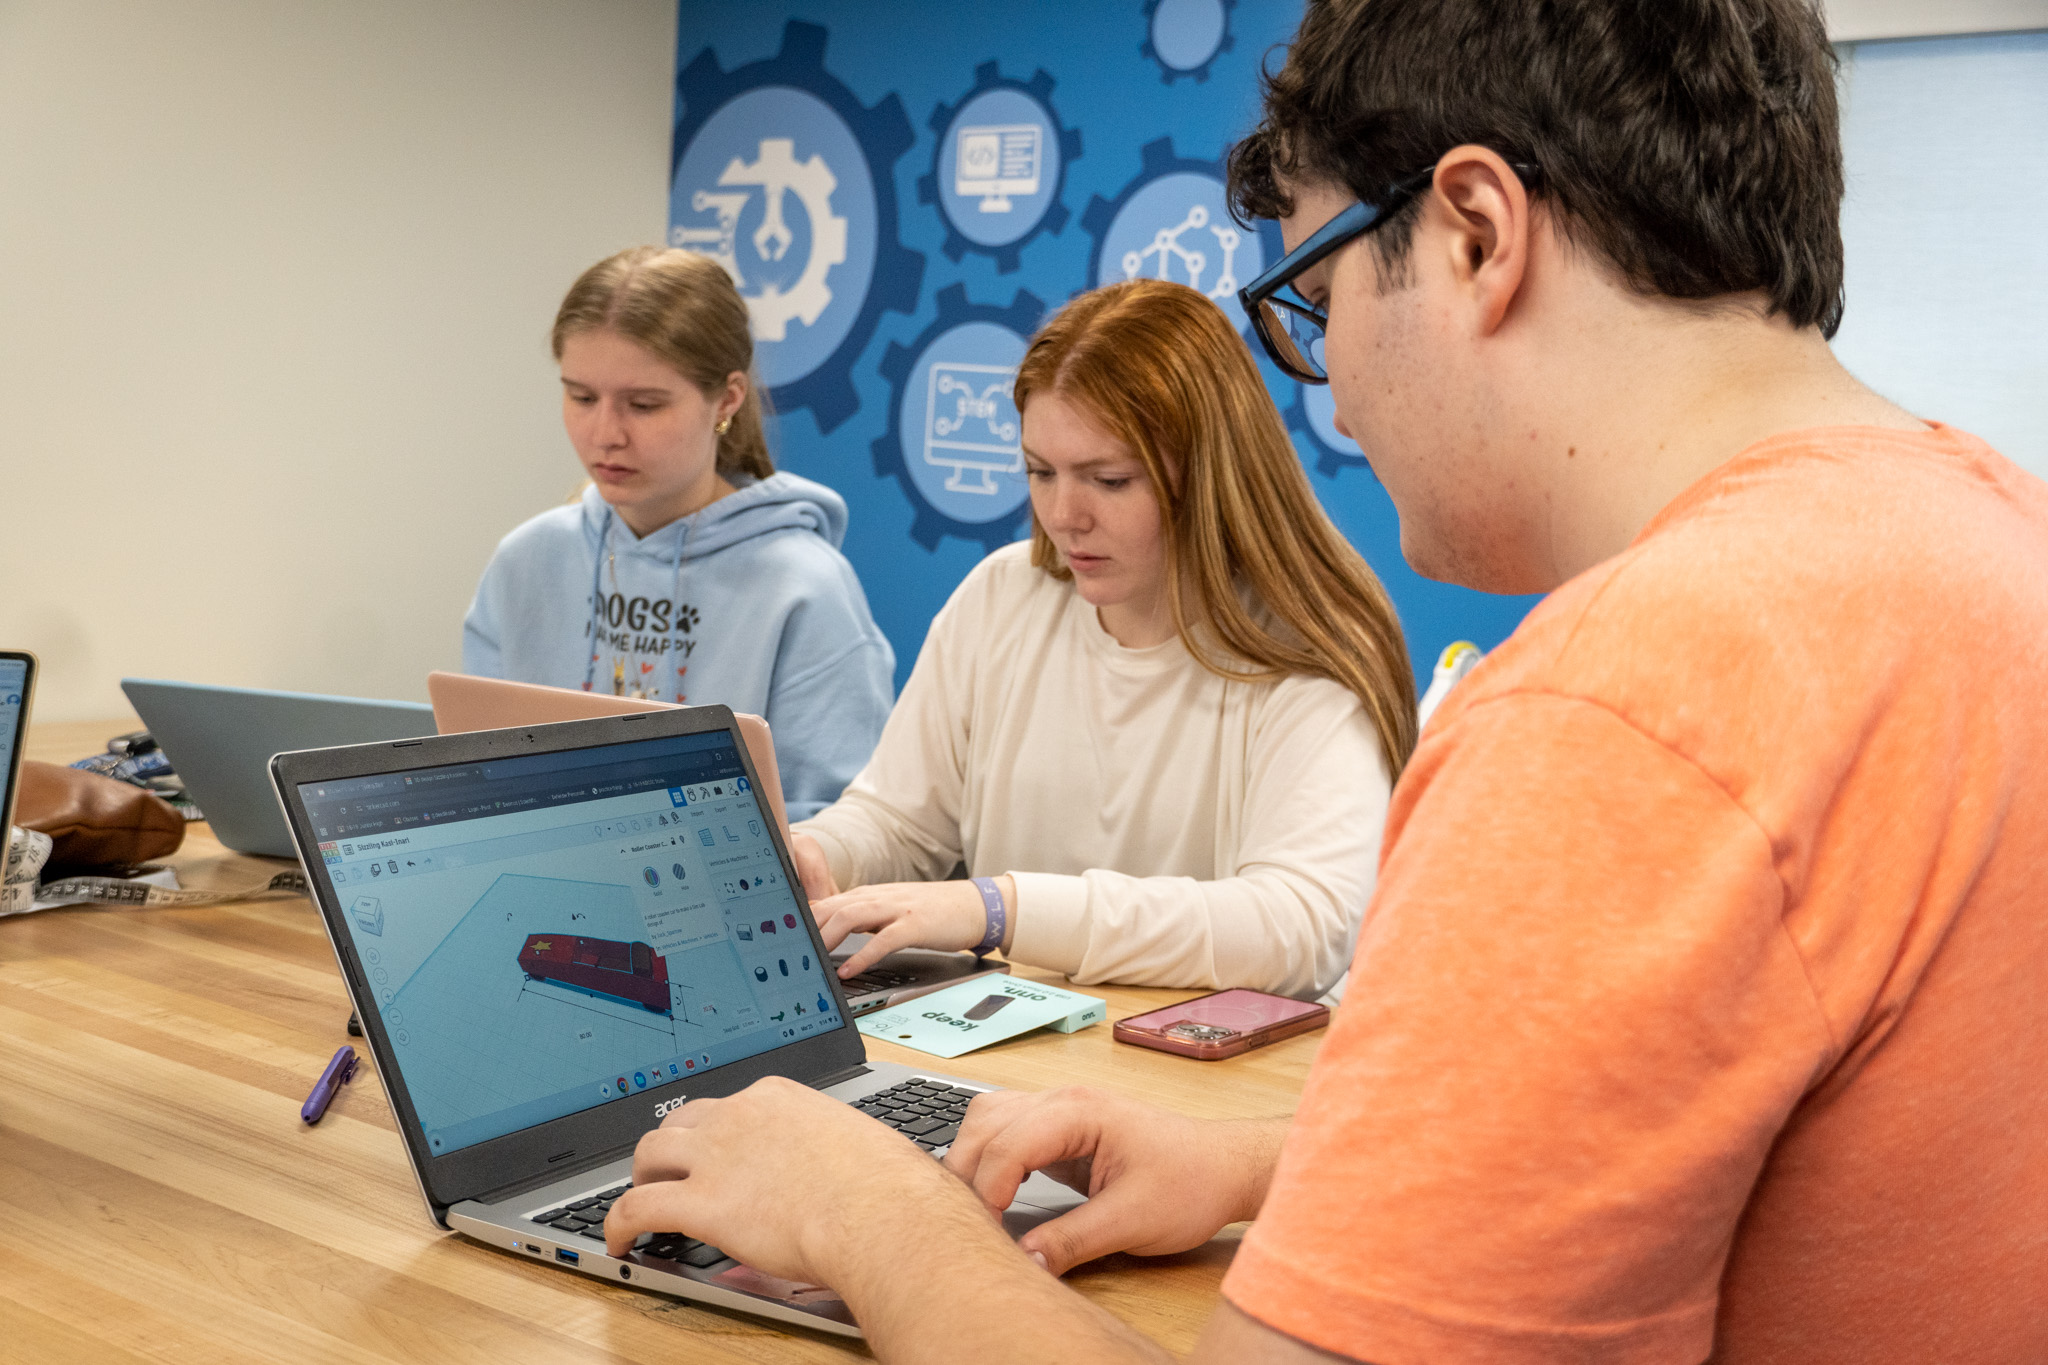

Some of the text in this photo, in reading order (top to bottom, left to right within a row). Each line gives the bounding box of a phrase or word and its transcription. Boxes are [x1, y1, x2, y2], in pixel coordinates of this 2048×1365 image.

[957, 397, 997, 419] STEM
[356, 841, 381, 852] Sizzling
[630, 845, 645, 853] Roller
[643, 842, 661, 850] Coaster
[729, 854, 749, 862] Machines
[1004, 986, 1047, 1001] onn.
[921, 1011, 980, 1032] keep
[1081, 1011, 1096, 1021] onn.
[654, 1095, 687, 1118] acer
